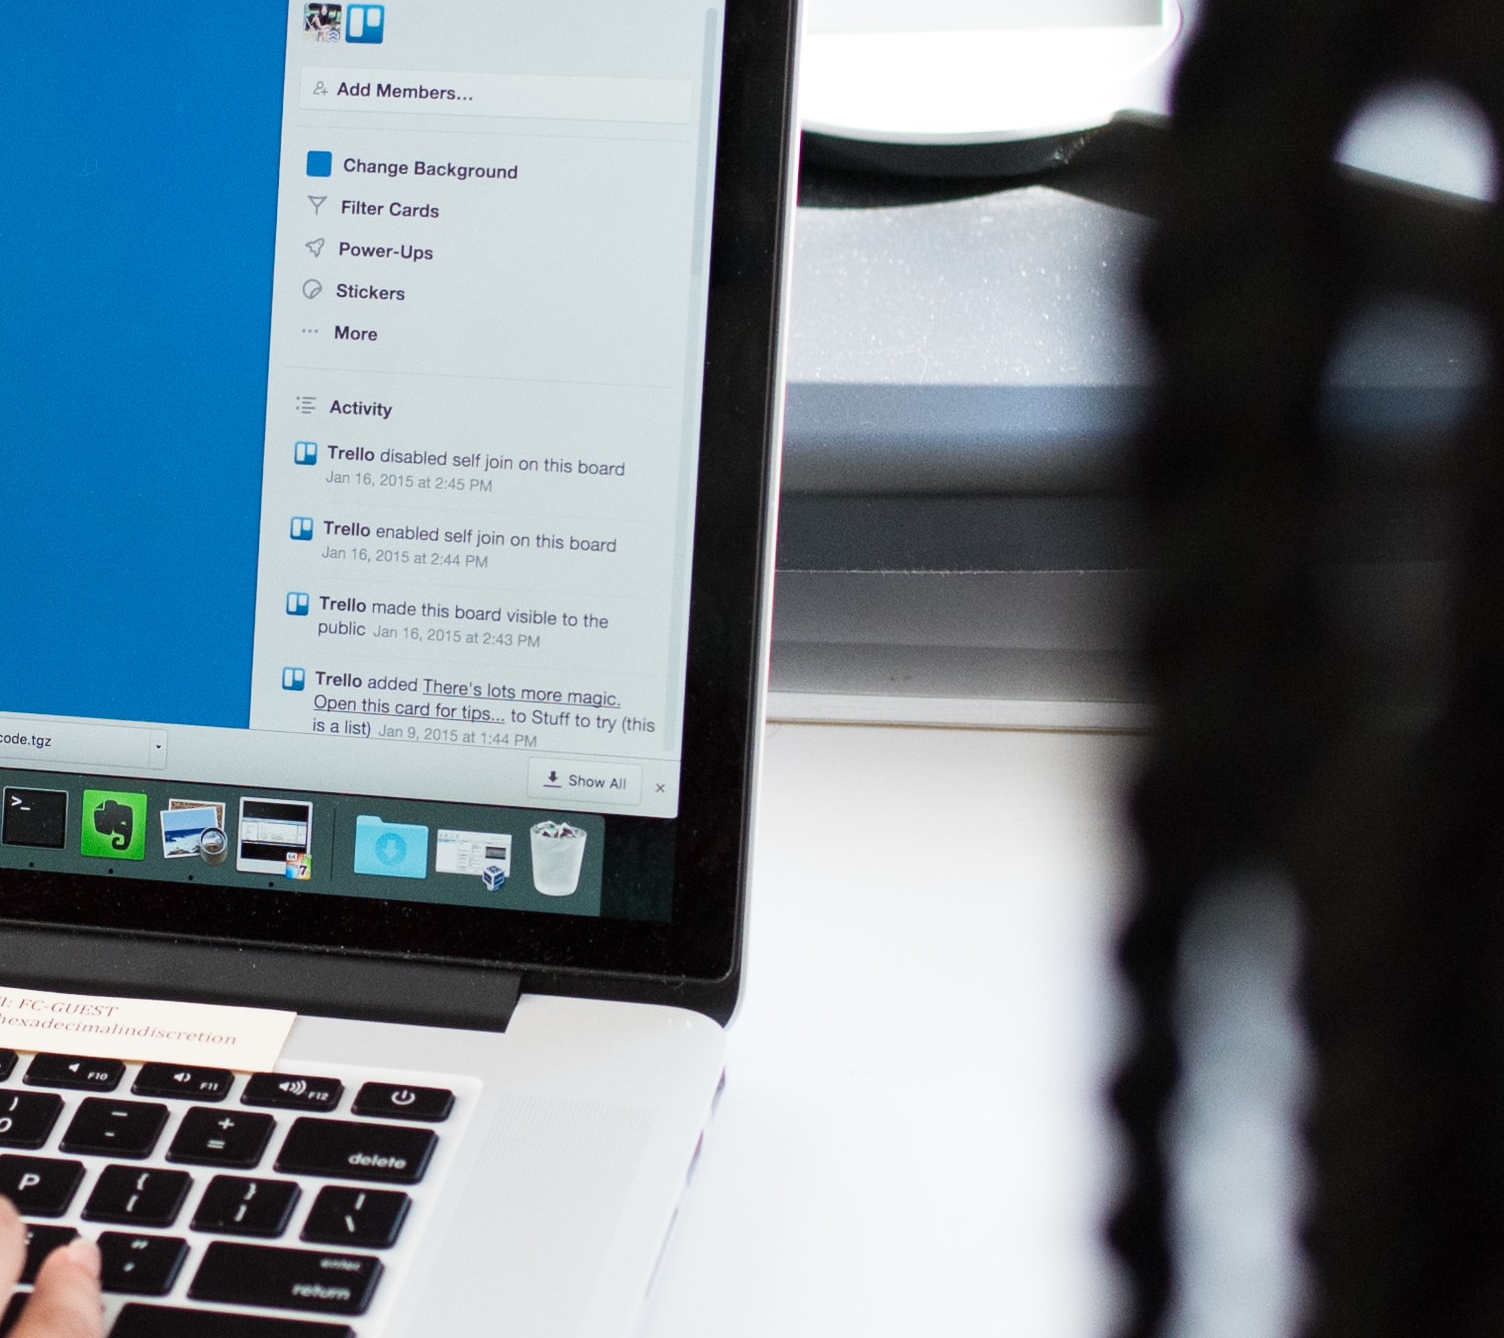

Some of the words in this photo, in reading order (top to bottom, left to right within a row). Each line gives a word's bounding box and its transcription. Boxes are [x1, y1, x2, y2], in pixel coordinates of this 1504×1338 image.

[336, 81, 371, 97] Add
[343, 157, 408, 177] Change
[414, 160, 518, 180] Background
[341, 199, 384, 215] Filter
[389, 201, 439, 218] Cards
[338, 241, 433, 262] Power-Ups
[336, 283, 405, 301] Stickers
[334, 325, 377, 341] More
[329, 399, 392, 420] Activity
[327, 444, 375, 462] Trello
[379, 448, 447, 466] disabled
[452, 453, 481, 467] self
[484, 454, 513, 471] join
[518, 459, 538, 471] on
[543, 458, 572, 473] this
[577, 459, 625, 476] board
[325, 470, 350, 484] Jan
[355, 472, 375, 487] 16,
[379, 473, 414, 488] 2015
[417, 476, 431, 489] at
[434, 476, 465, 491] 2:45
[469, 478, 492, 492] PM
[568, 773, 605, 788] Show
[609, 777, 626, 789] All
[18, 998, 119, 1017] FC-GUEST
[307, 1091, 329, 1101] F12
[348, 1152, 406, 1169] delete
[17, 1174, 41, 1190] P
[292, 1284, 350, 1300] return
